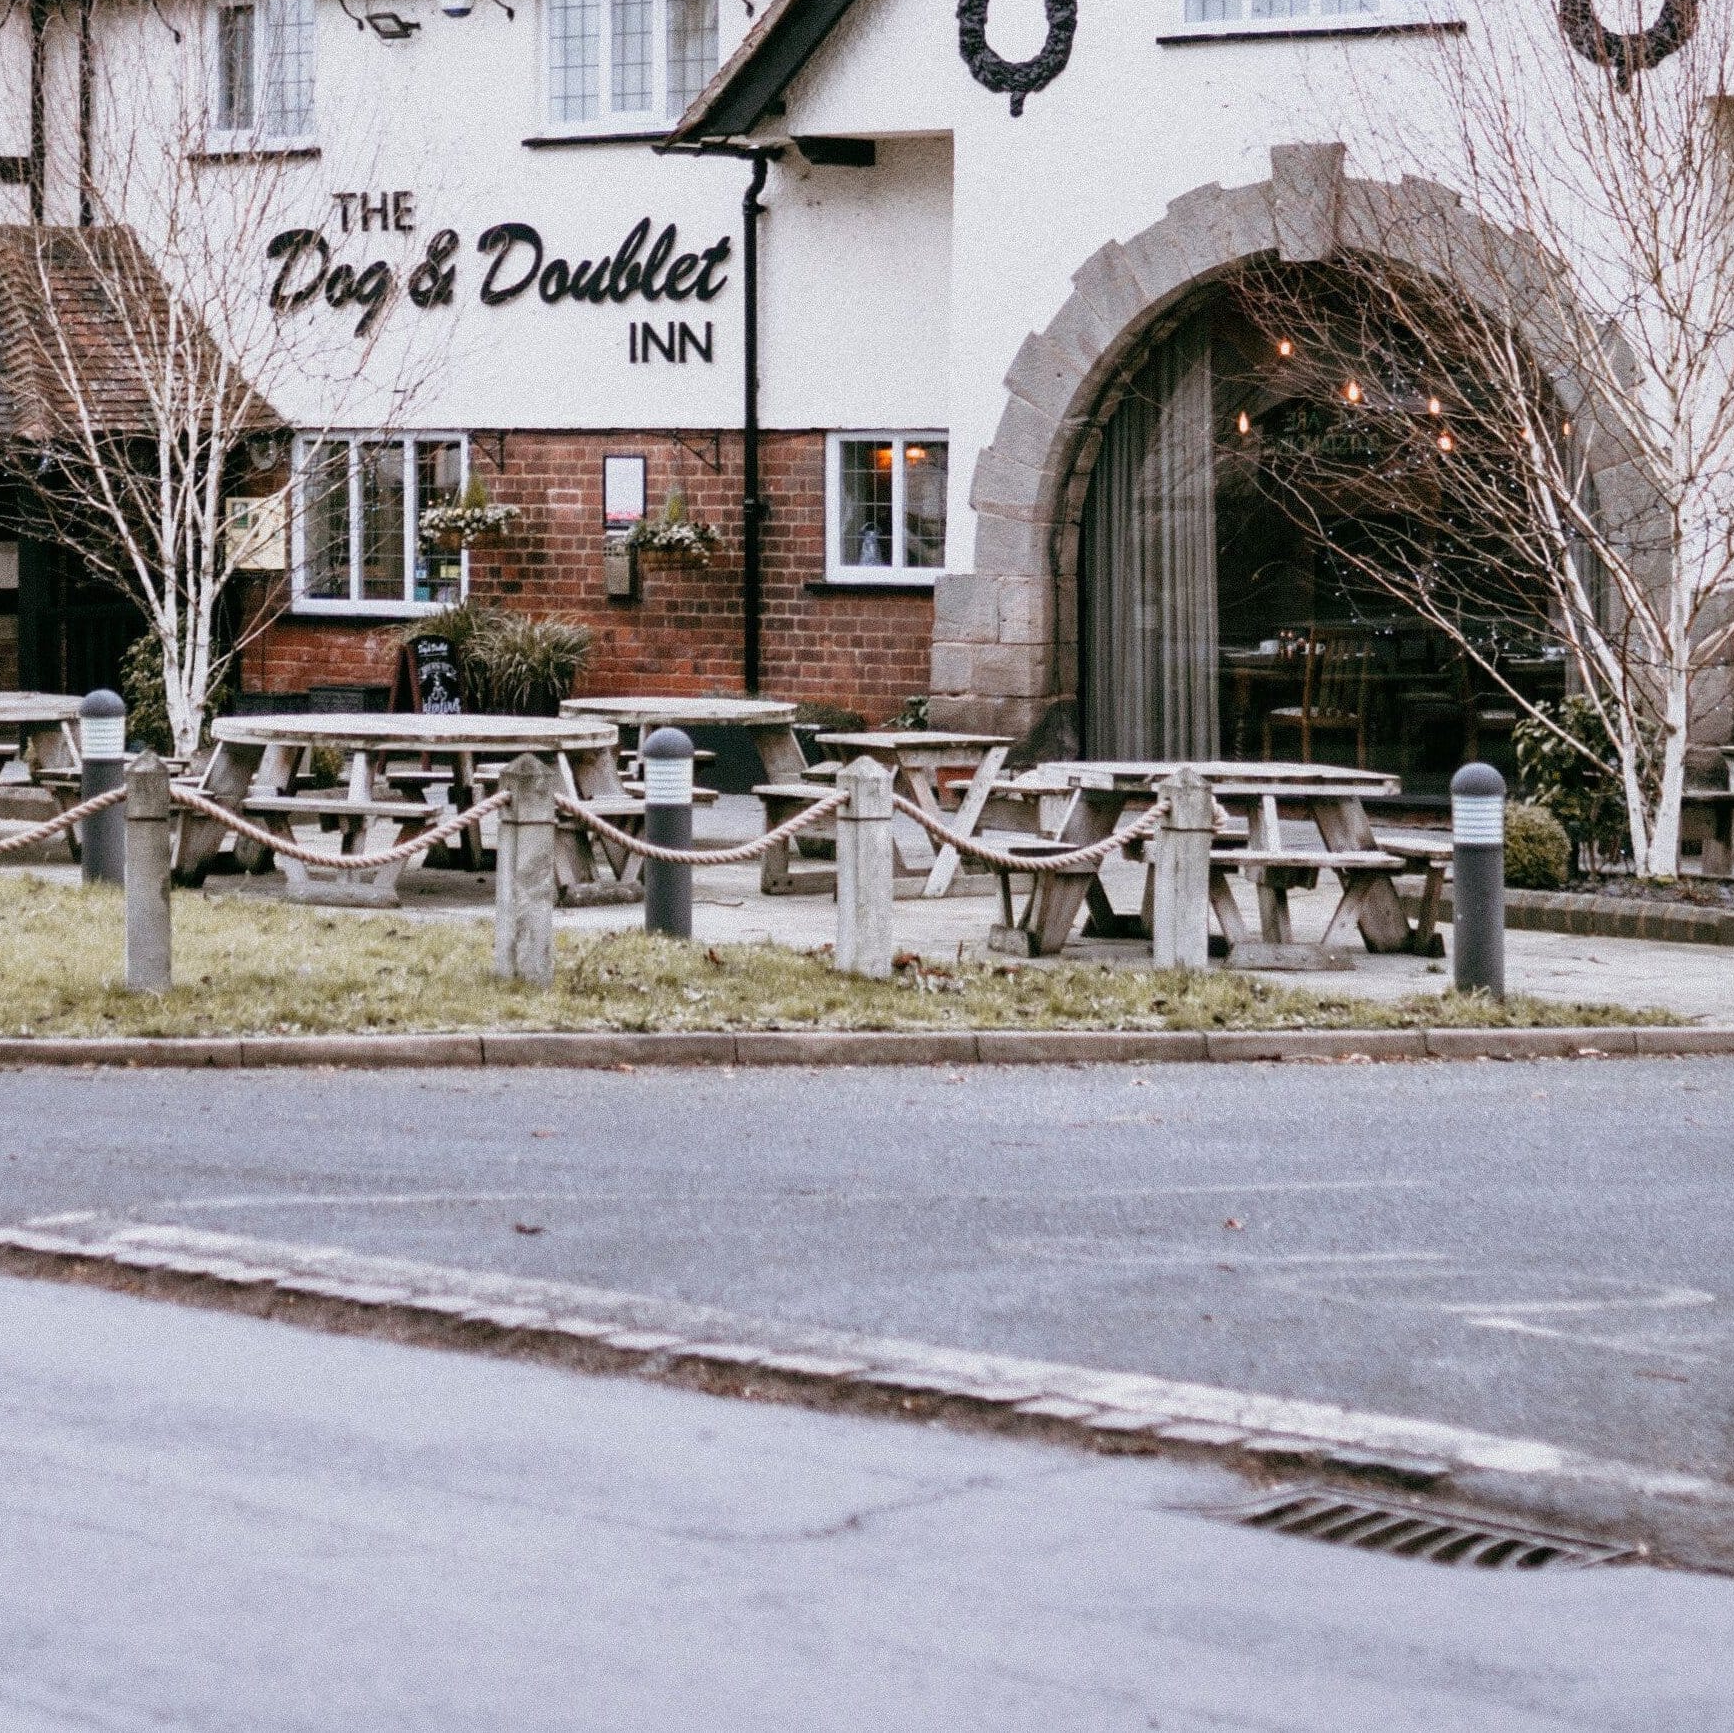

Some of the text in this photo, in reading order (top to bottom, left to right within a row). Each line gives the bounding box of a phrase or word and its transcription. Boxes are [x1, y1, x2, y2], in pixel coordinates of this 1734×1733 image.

[332, 190, 415, 232] THE
[265, 216, 733, 339] Dog & Doublet
[629, 322, 714, 364] INN
